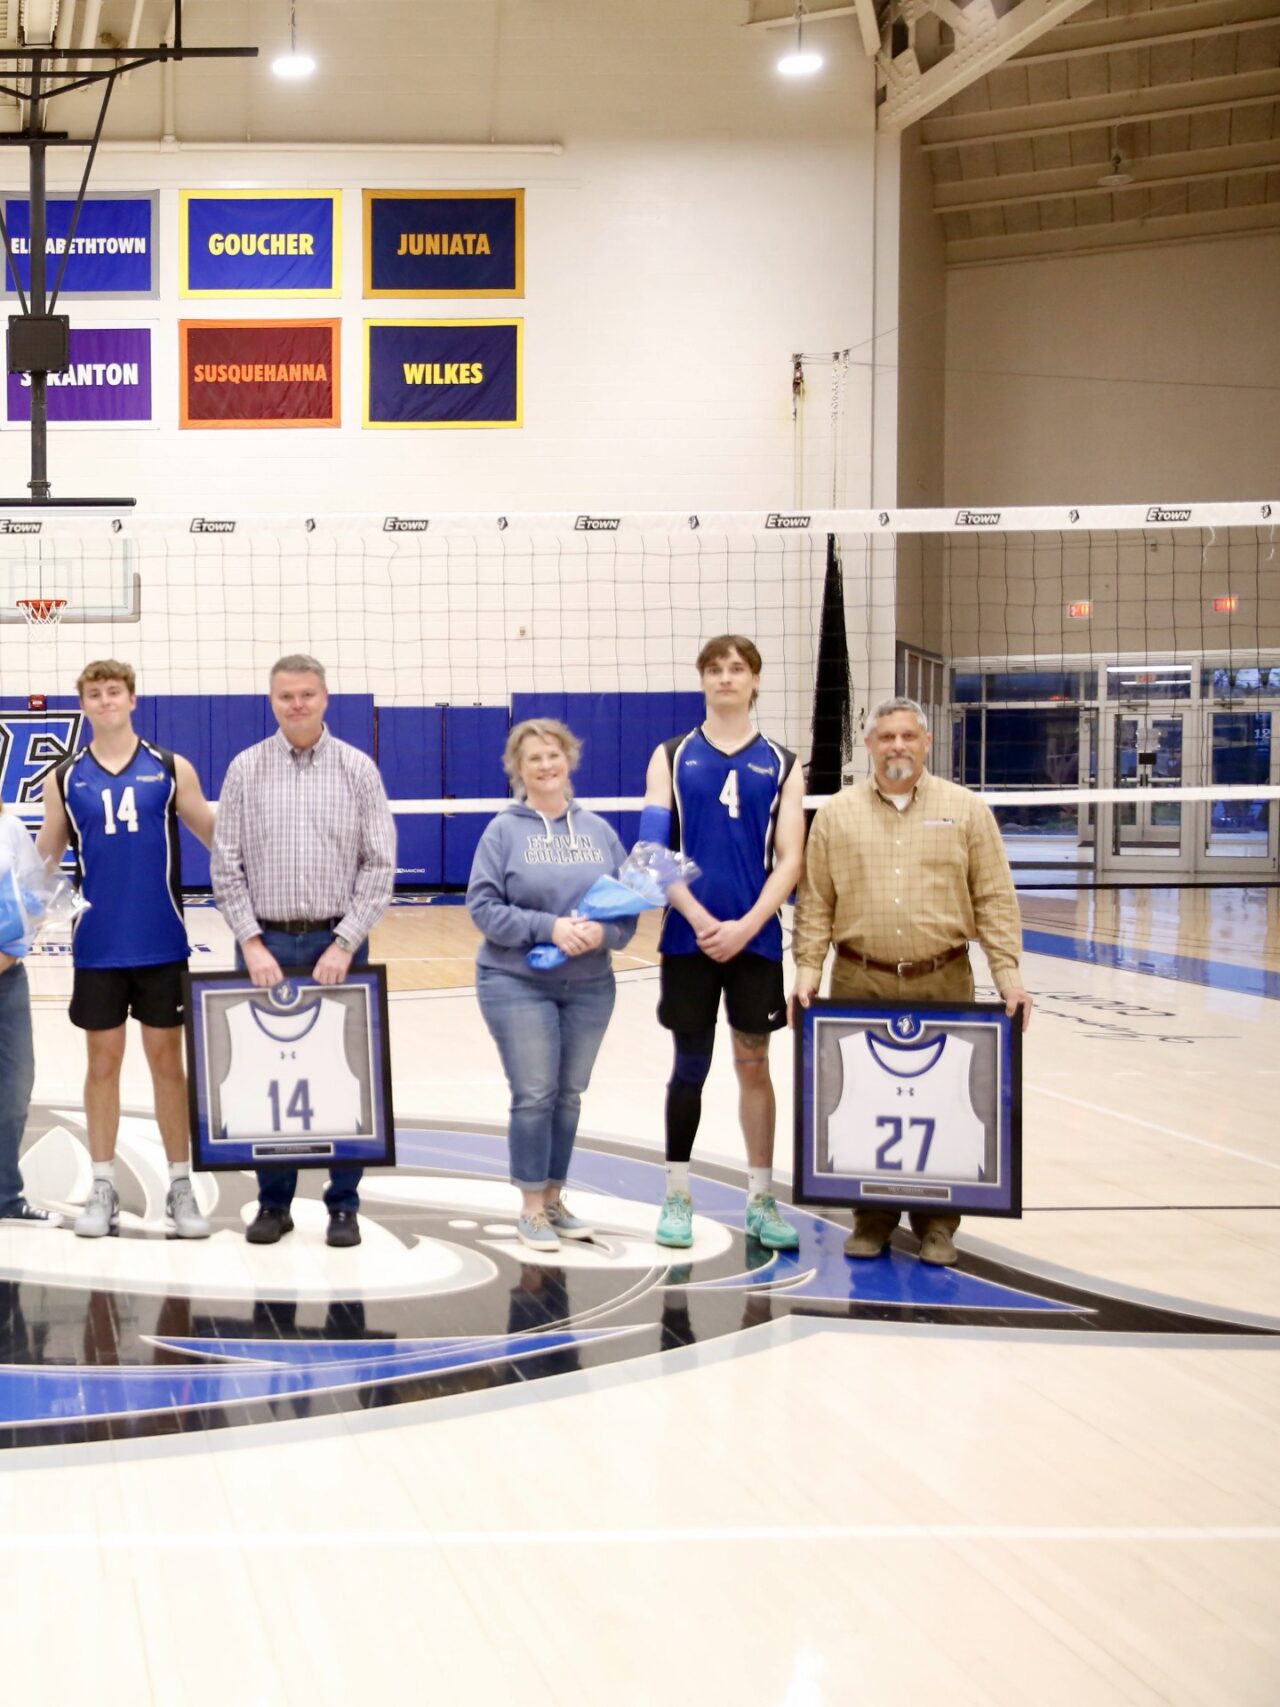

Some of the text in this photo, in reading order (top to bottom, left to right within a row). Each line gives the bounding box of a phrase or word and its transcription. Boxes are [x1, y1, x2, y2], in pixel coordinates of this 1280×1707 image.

[11, 237, 146, 255] ELABETHTOWN
[208, 233, 314, 256] GOUCHER
[397, 233, 491, 256] JUNIATA
[20, 363, 139, 387] SRANTON
[193, 364, 327, 383] SUSQUEHANNA
[403, 363, 484, 385] WILKES
[719, 769, 740, 819] 4
[101, 786, 139, 835] 14
[267, 1079, 314, 1132] 14
[875, 1116, 936, 1172] 27
